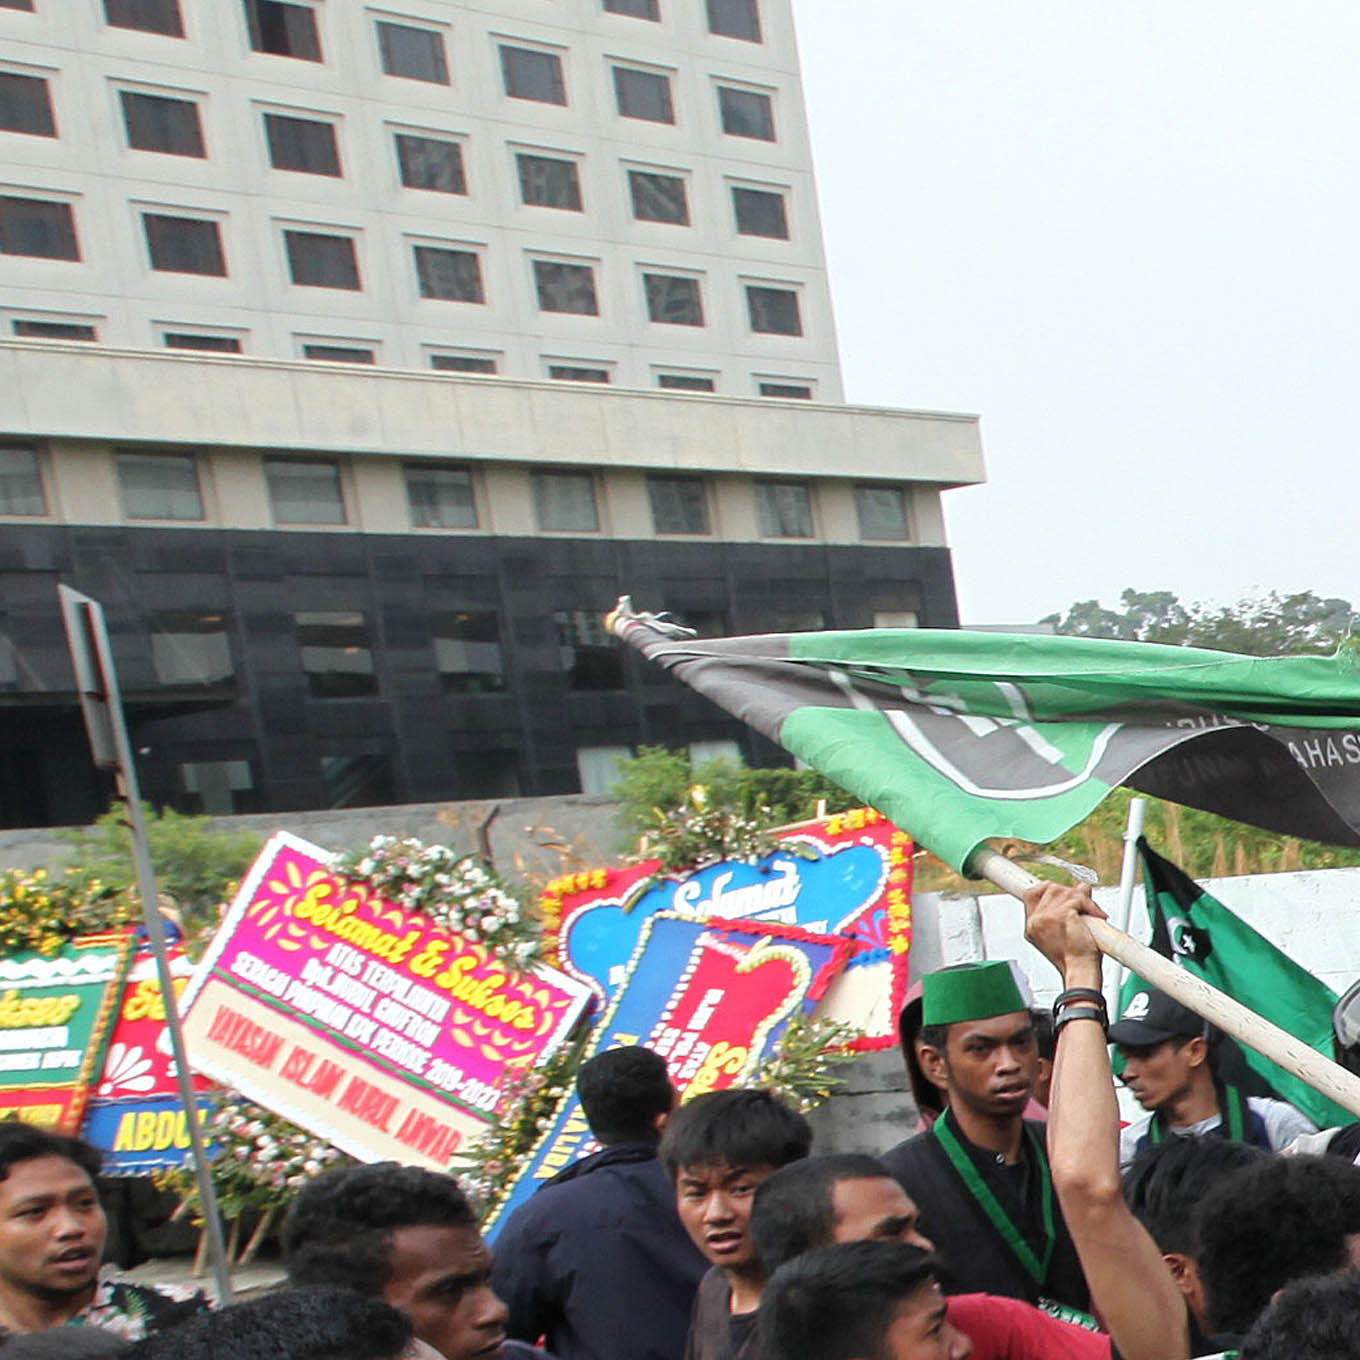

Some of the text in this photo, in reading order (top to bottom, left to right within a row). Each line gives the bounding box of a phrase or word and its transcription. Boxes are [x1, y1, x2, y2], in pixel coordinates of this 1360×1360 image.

[228, 950, 291, 998] SEBAGAI
[343, 1012, 379, 1046] KPK
[370, 1028, 431, 1075] PERIODE
[294, 881, 536, 1030] Selamat & Sukses
[324, 941, 366, 978] ATAS
[206, 1004, 464, 1167] YAYASAN ISLAM NURUL ANWAR
